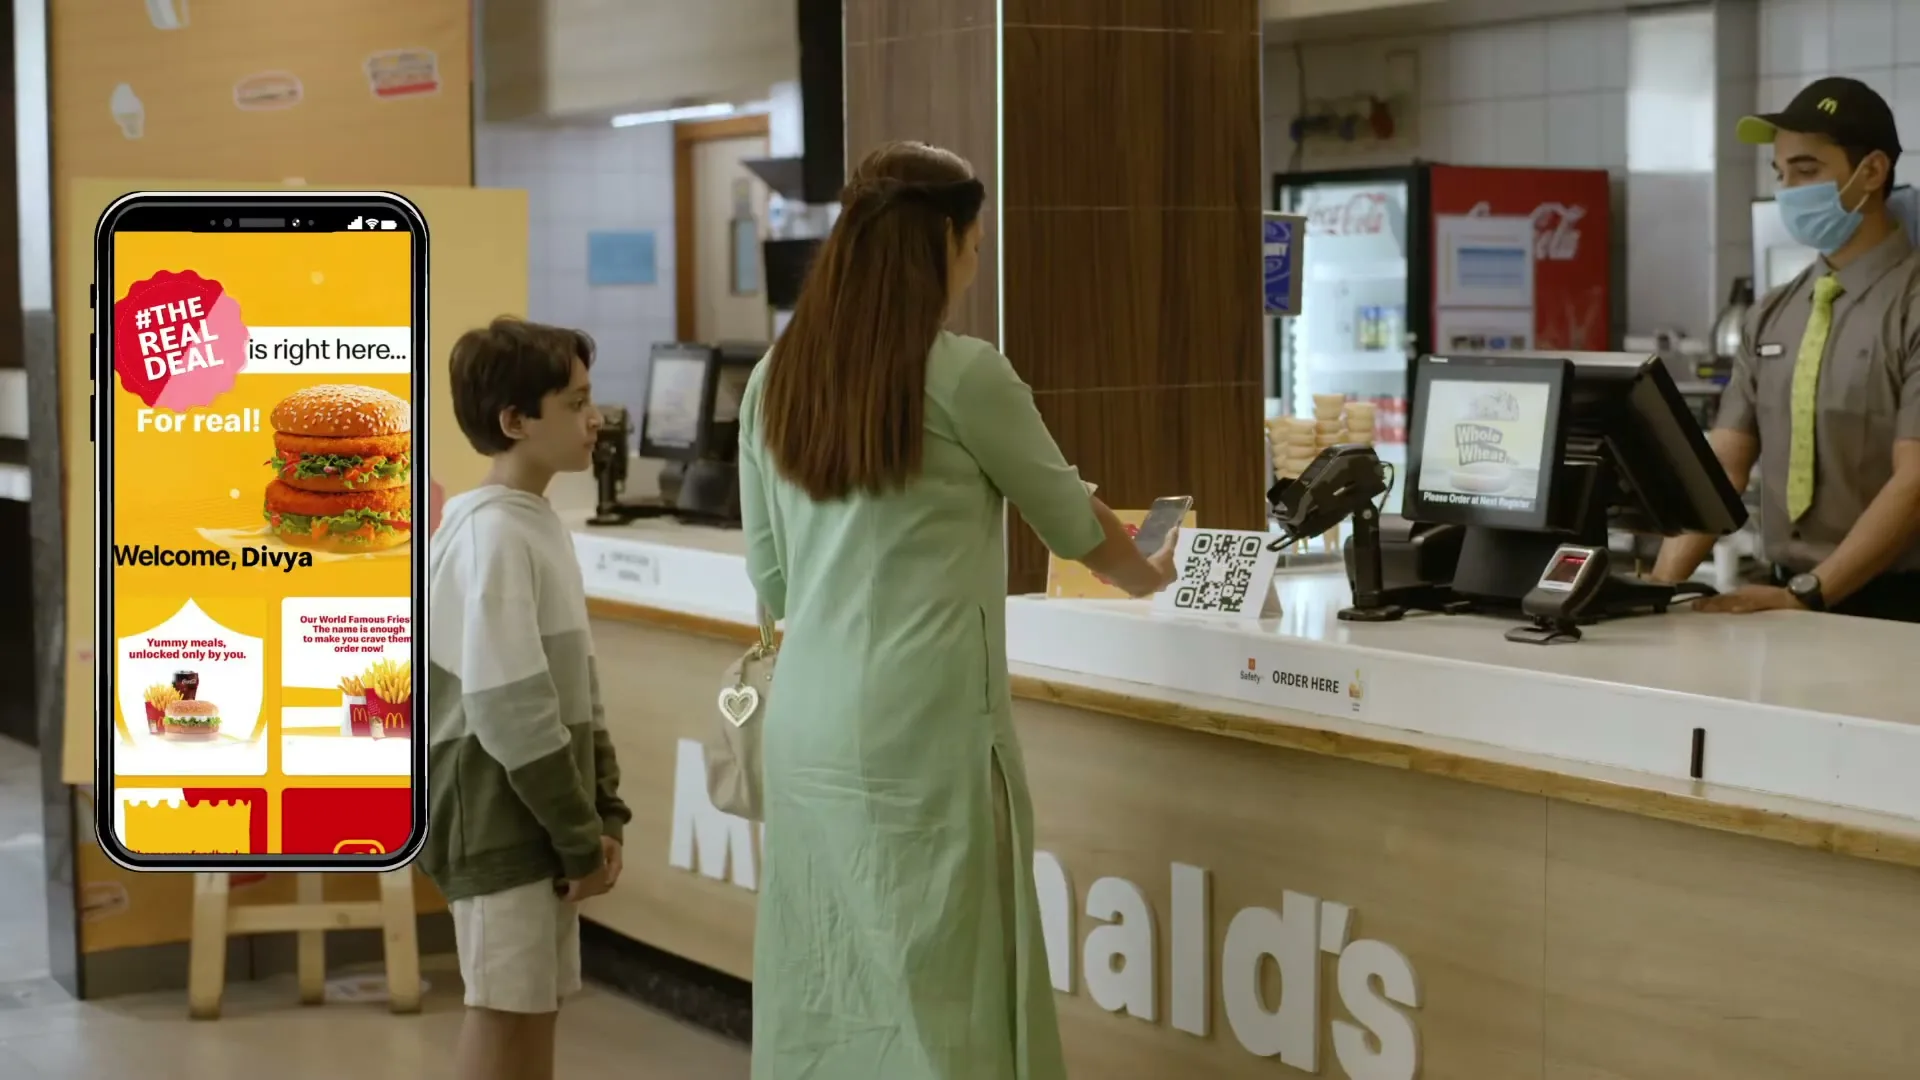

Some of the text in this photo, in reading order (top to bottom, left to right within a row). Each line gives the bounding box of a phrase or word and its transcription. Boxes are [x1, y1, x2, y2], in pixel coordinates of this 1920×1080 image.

[1456, 425, 1502, 443] Whole
[1460, 444, 1505, 465] Wheat
[1423, 491, 1530, 510] Please Order at Next Register
[1240, 670, 1261, 684] Safety
[1272, 670, 1340, 694] ORDER HERE
